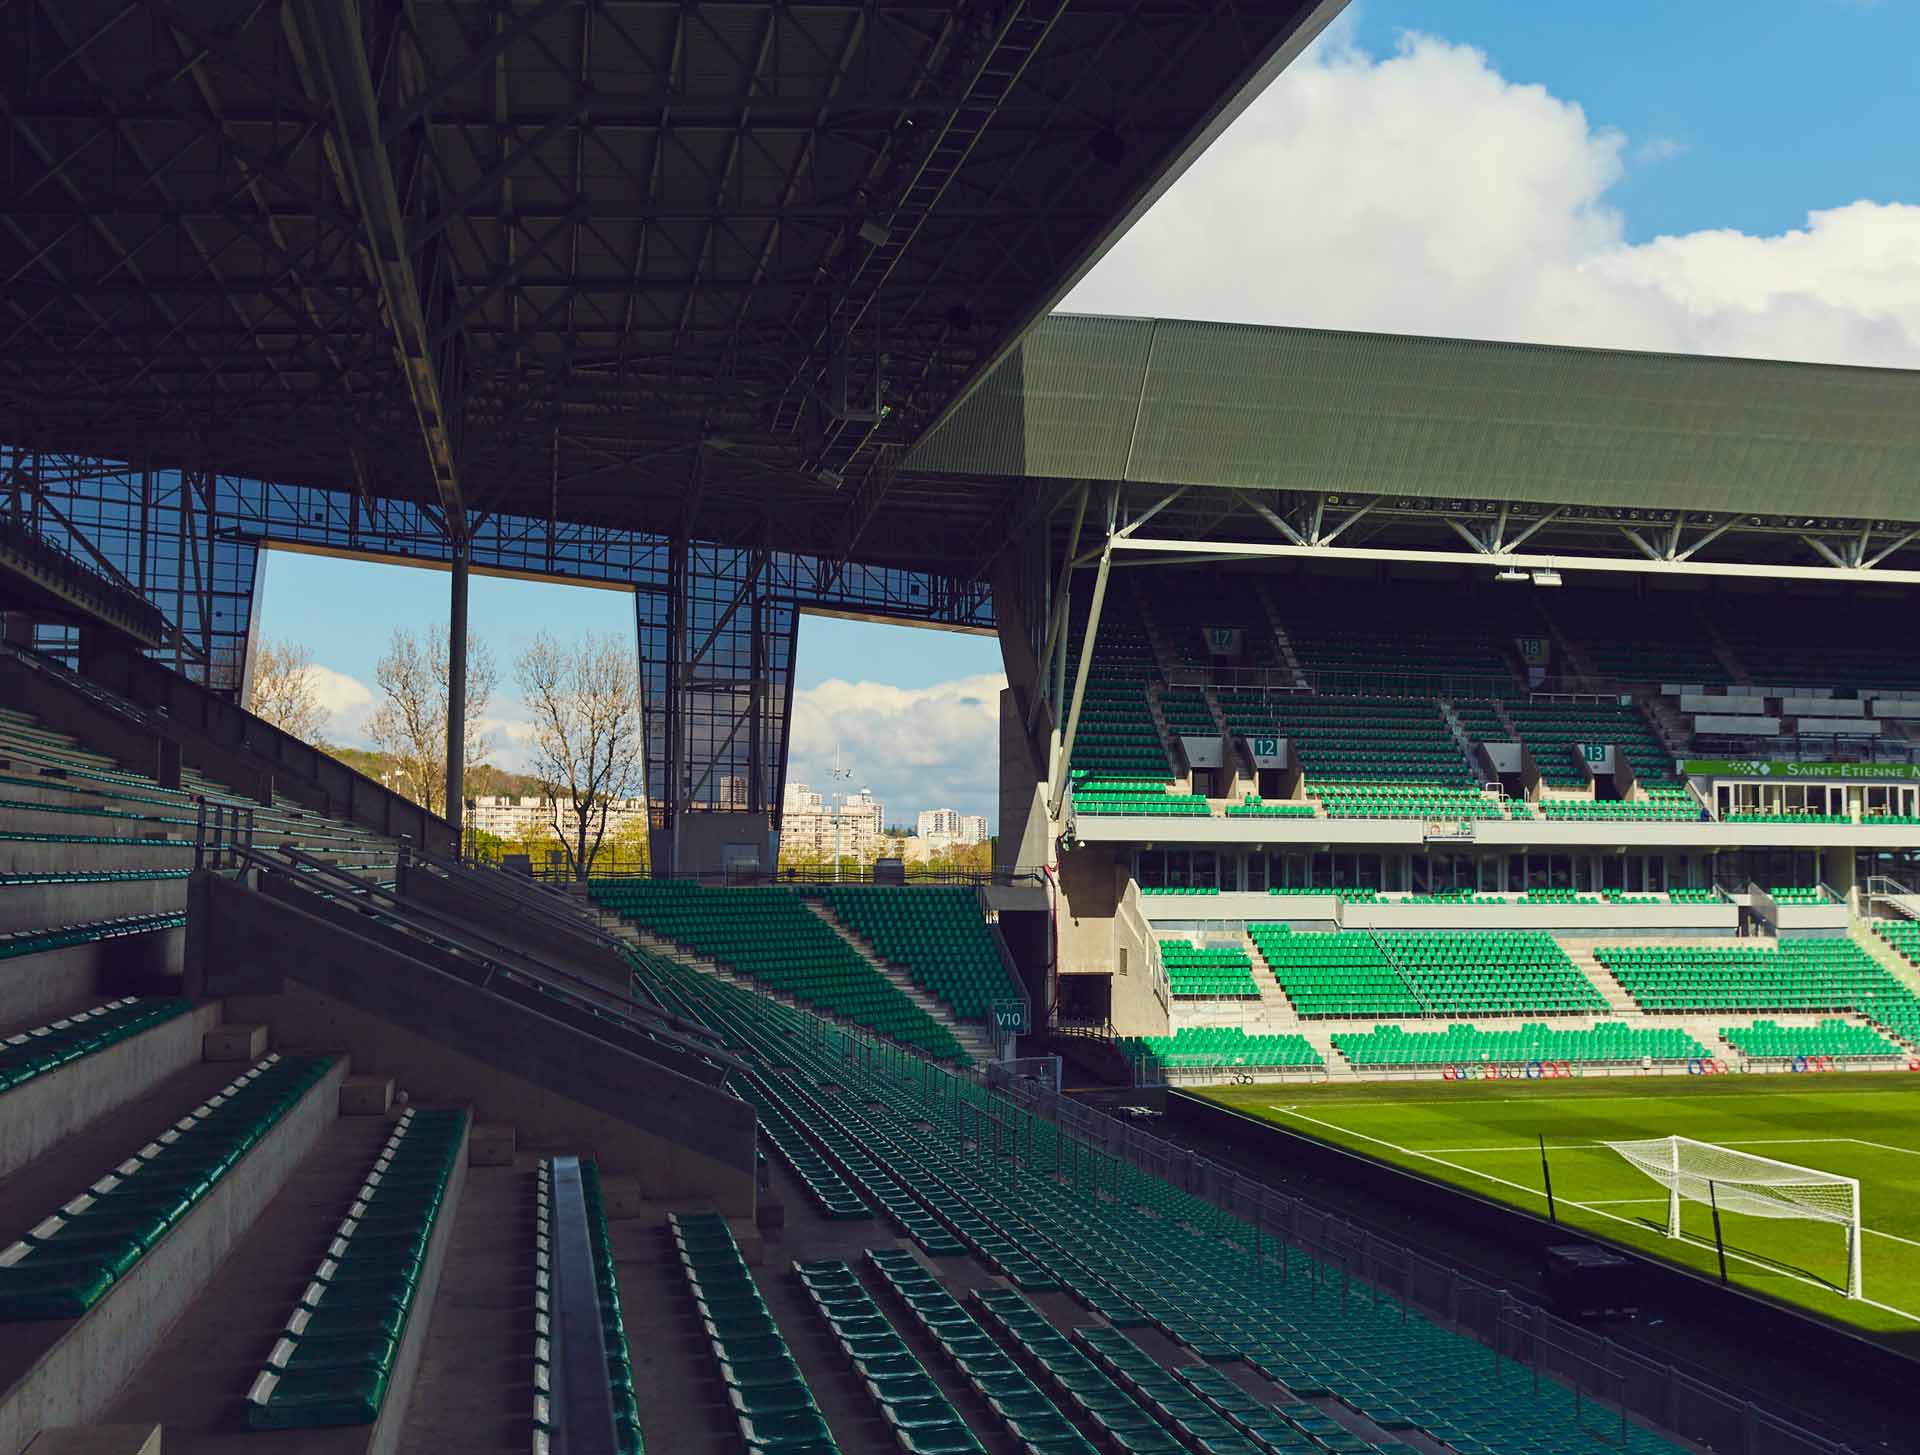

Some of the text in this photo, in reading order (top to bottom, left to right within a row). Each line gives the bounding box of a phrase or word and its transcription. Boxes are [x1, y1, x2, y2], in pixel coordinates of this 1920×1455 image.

[1215, 631, 1230, 644] 17
[1523, 640, 1539, 652] 18
[1257, 740, 1275, 755] 12
[1587, 746, 1602, 761] 13
[996, 1012, 1021, 1026] V10
